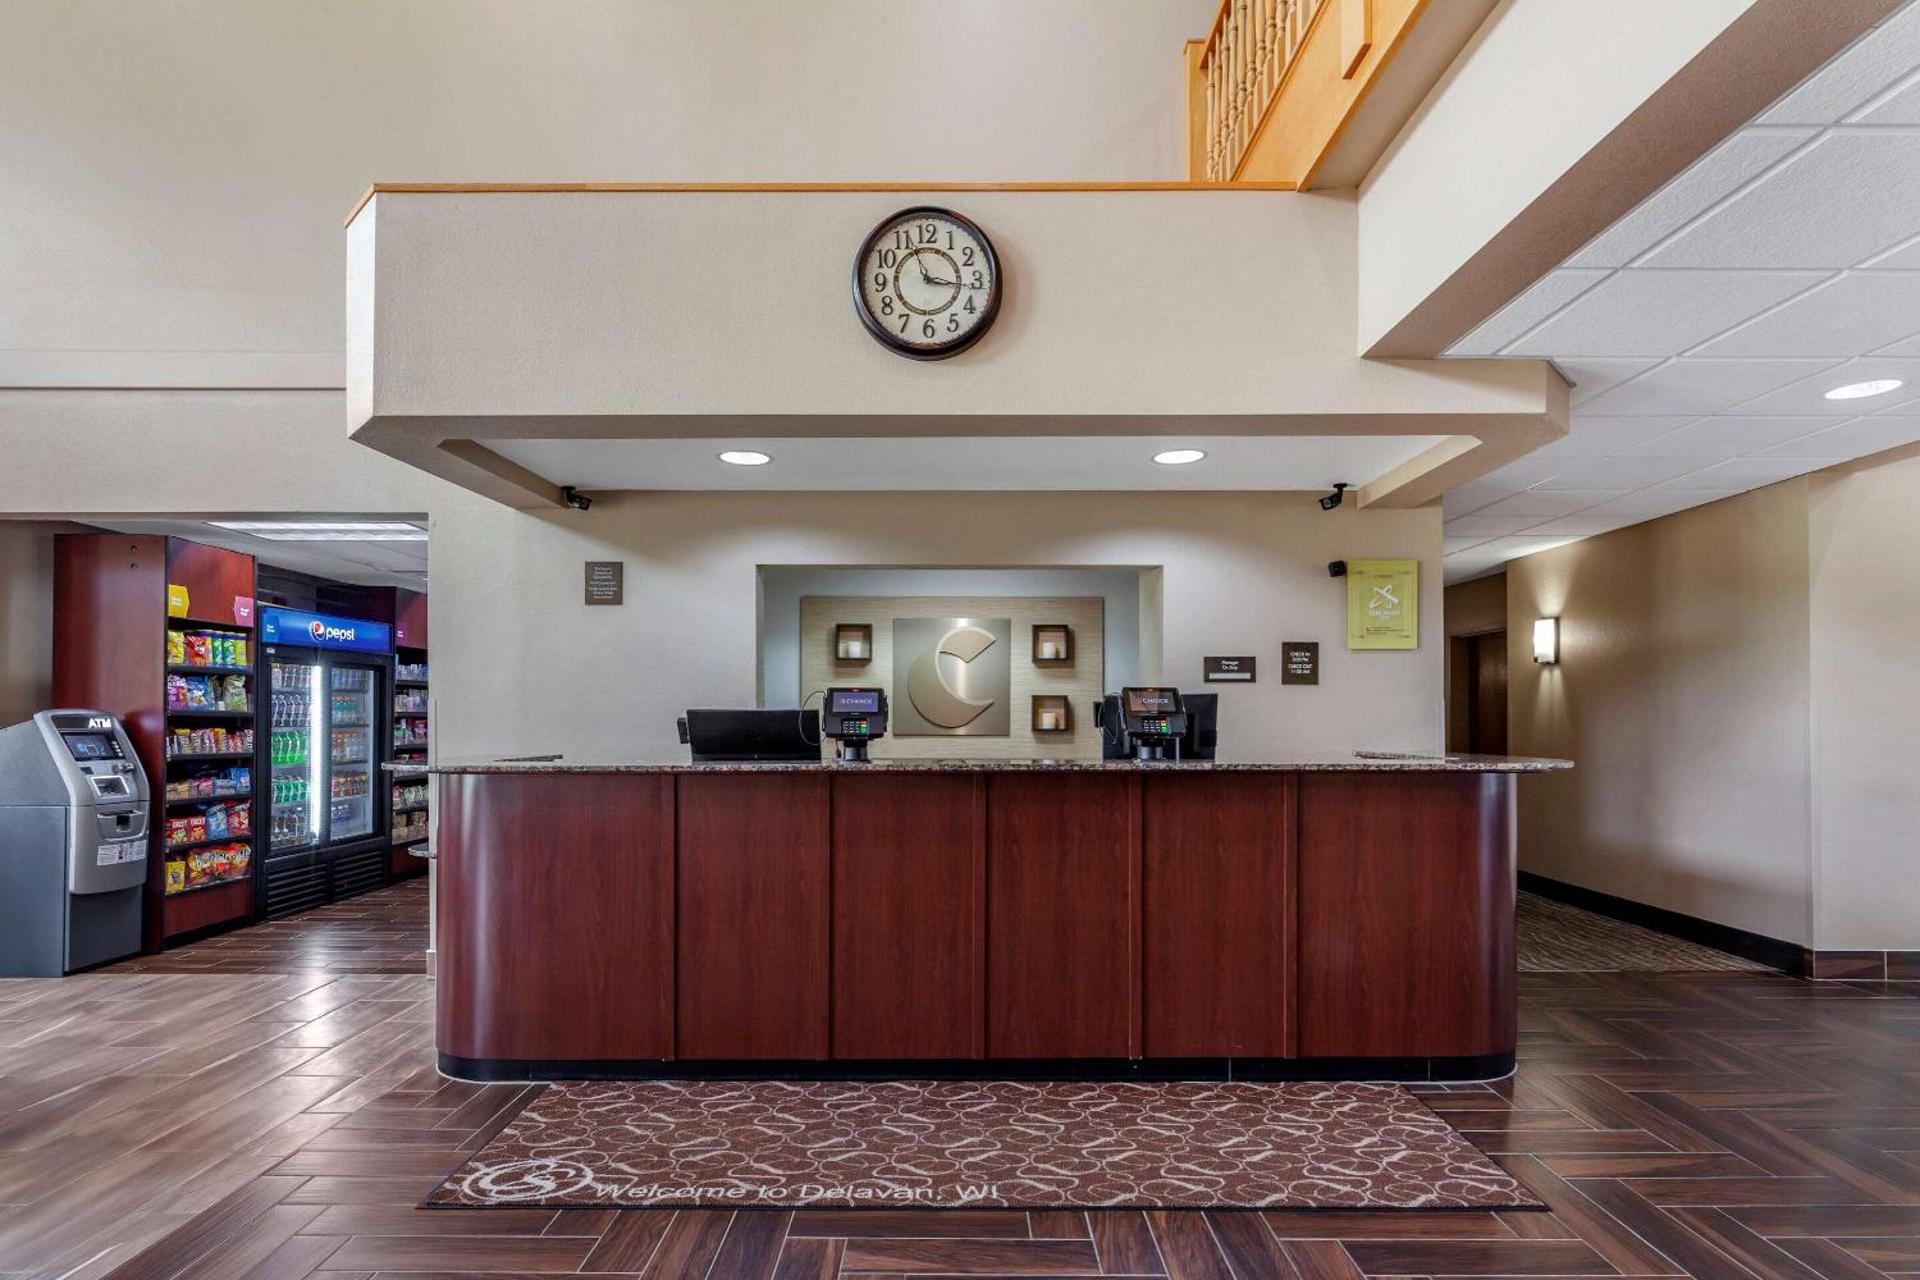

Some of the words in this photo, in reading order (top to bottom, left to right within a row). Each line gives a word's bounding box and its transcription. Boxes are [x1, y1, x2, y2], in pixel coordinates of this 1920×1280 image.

[894, 230, 911, 250] 11
[918, 223, 937, 244] 12
[946, 230, 954, 250] 1
[876, 248, 897, 269] 10
[962, 247, 974, 267] 2
[874, 272, 887, 293] 9
[971, 270, 983, 290] 3
[881, 296, 894, 316] 8
[963, 295, 976, 314] 4
[898, 314, 910, 334] 7
[922, 319, 935, 339] 6
[946, 313, 959, 332] 5
[325, 627, 355, 642] pepsi
[88, 718, 112, 729] ATM
[596, 1184, 747, 1199] Welcome
[758, 1184, 788, 1199] to
[800, 1184, 943, 1201] Delavan,
[955, 1184, 999, 1199] WI
